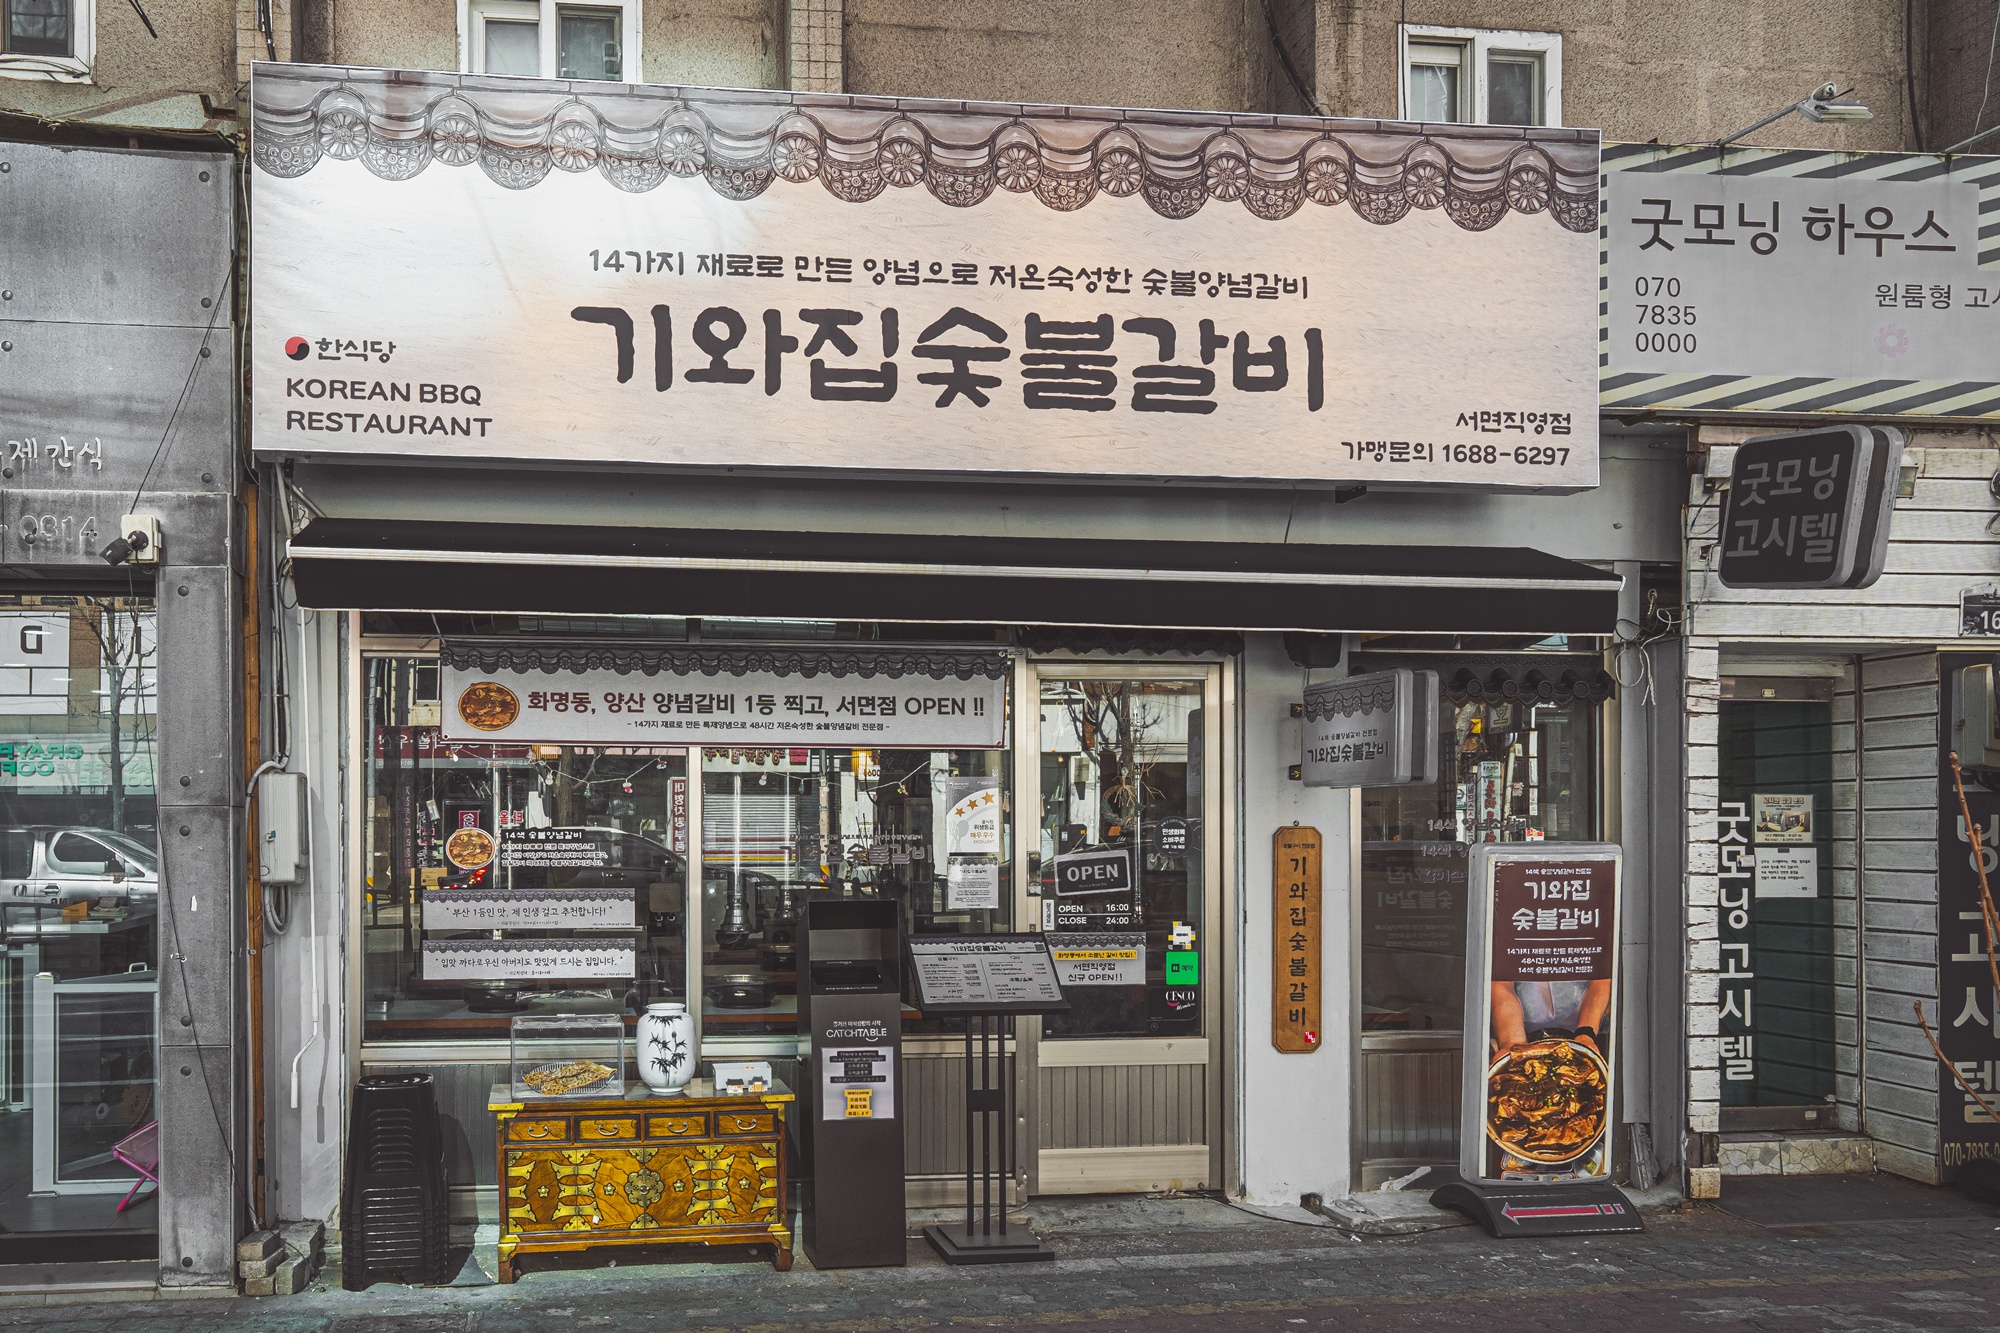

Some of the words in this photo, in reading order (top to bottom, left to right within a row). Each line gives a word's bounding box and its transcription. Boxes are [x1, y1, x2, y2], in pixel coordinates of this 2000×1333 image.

[1631, 198, 1780, 255] 굿모닝
[1802, 202, 1956, 258] 하우스
[589, 249, 685, 276] 14가지
[697, 253, 785, 279] 재료로
[795, 256, 854, 284] 만든
[863, 258, 979, 286] 양념으로
[989, 263, 1133, 294] 저온숙성한
[1142, 269, 1309, 300] 숯불양념갈비
[1635, 277, 1681, 297] 070
[1875, 283, 1952, 310] 원룸형
[1635, 305, 1697, 326] 7835
[315, 337, 396, 364] 한식당
[1635, 333, 1697, 354] 0000
[571, 304, 1326, 415] 기와집숯불갈비
[287, 378, 411, 404] KOREAN
[418, 384, 482, 407] BBQ
[287, 410, 493, 438] RESTAURANT
[1456, 411, 1572, 436] 서면직영점
[1340, 441, 1433, 464] 가맹문의
[1442, 444, 1571, 467] 1688-6297
[1741, 454, 1840, 507] 굿모닝
[1726, 513, 1838, 563] 고시텔
[528, 691, 596, 714] 화명동,
[603, 692, 645, 713] 양산
[653, 692, 735, 715] 양념갈비
[744, 694, 776, 715] 1등
[783, 694, 829, 718] 찍고,
[836, 695, 897, 717] 서면점
[904, 697, 966, 716] OPEN
[634, 720, 658, 729] 14가지
[685, 720, 701, 730] 만든
[749, 721, 775, 730] 48시간
[1307, 741, 1389, 764] 기와집숯불갈비
[1067, 863, 1119, 882] OPEN
[1524, 879, 1591, 901] 기와집
[452, 907, 470, 918] 부산
[1058, 905, 1083, 913] OPEN
[1106, 904, 1129, 912] 16:00
[1058, 916, 1087, 924] CLOSE
[1106, 916, 1129, 924] 24:00
[1512, 907, 1600, 931] 숯불갈비
[1288, 856, 1308, 1027] 기와집숯불갈비
[1068, 973, 1085, 981] 신규
[1073, 962, 1115, 971] 서면직영점
[1165, 991, 1195, 1001] CESCO
[826, 1028, 887, 1038] CATCHTABLE
